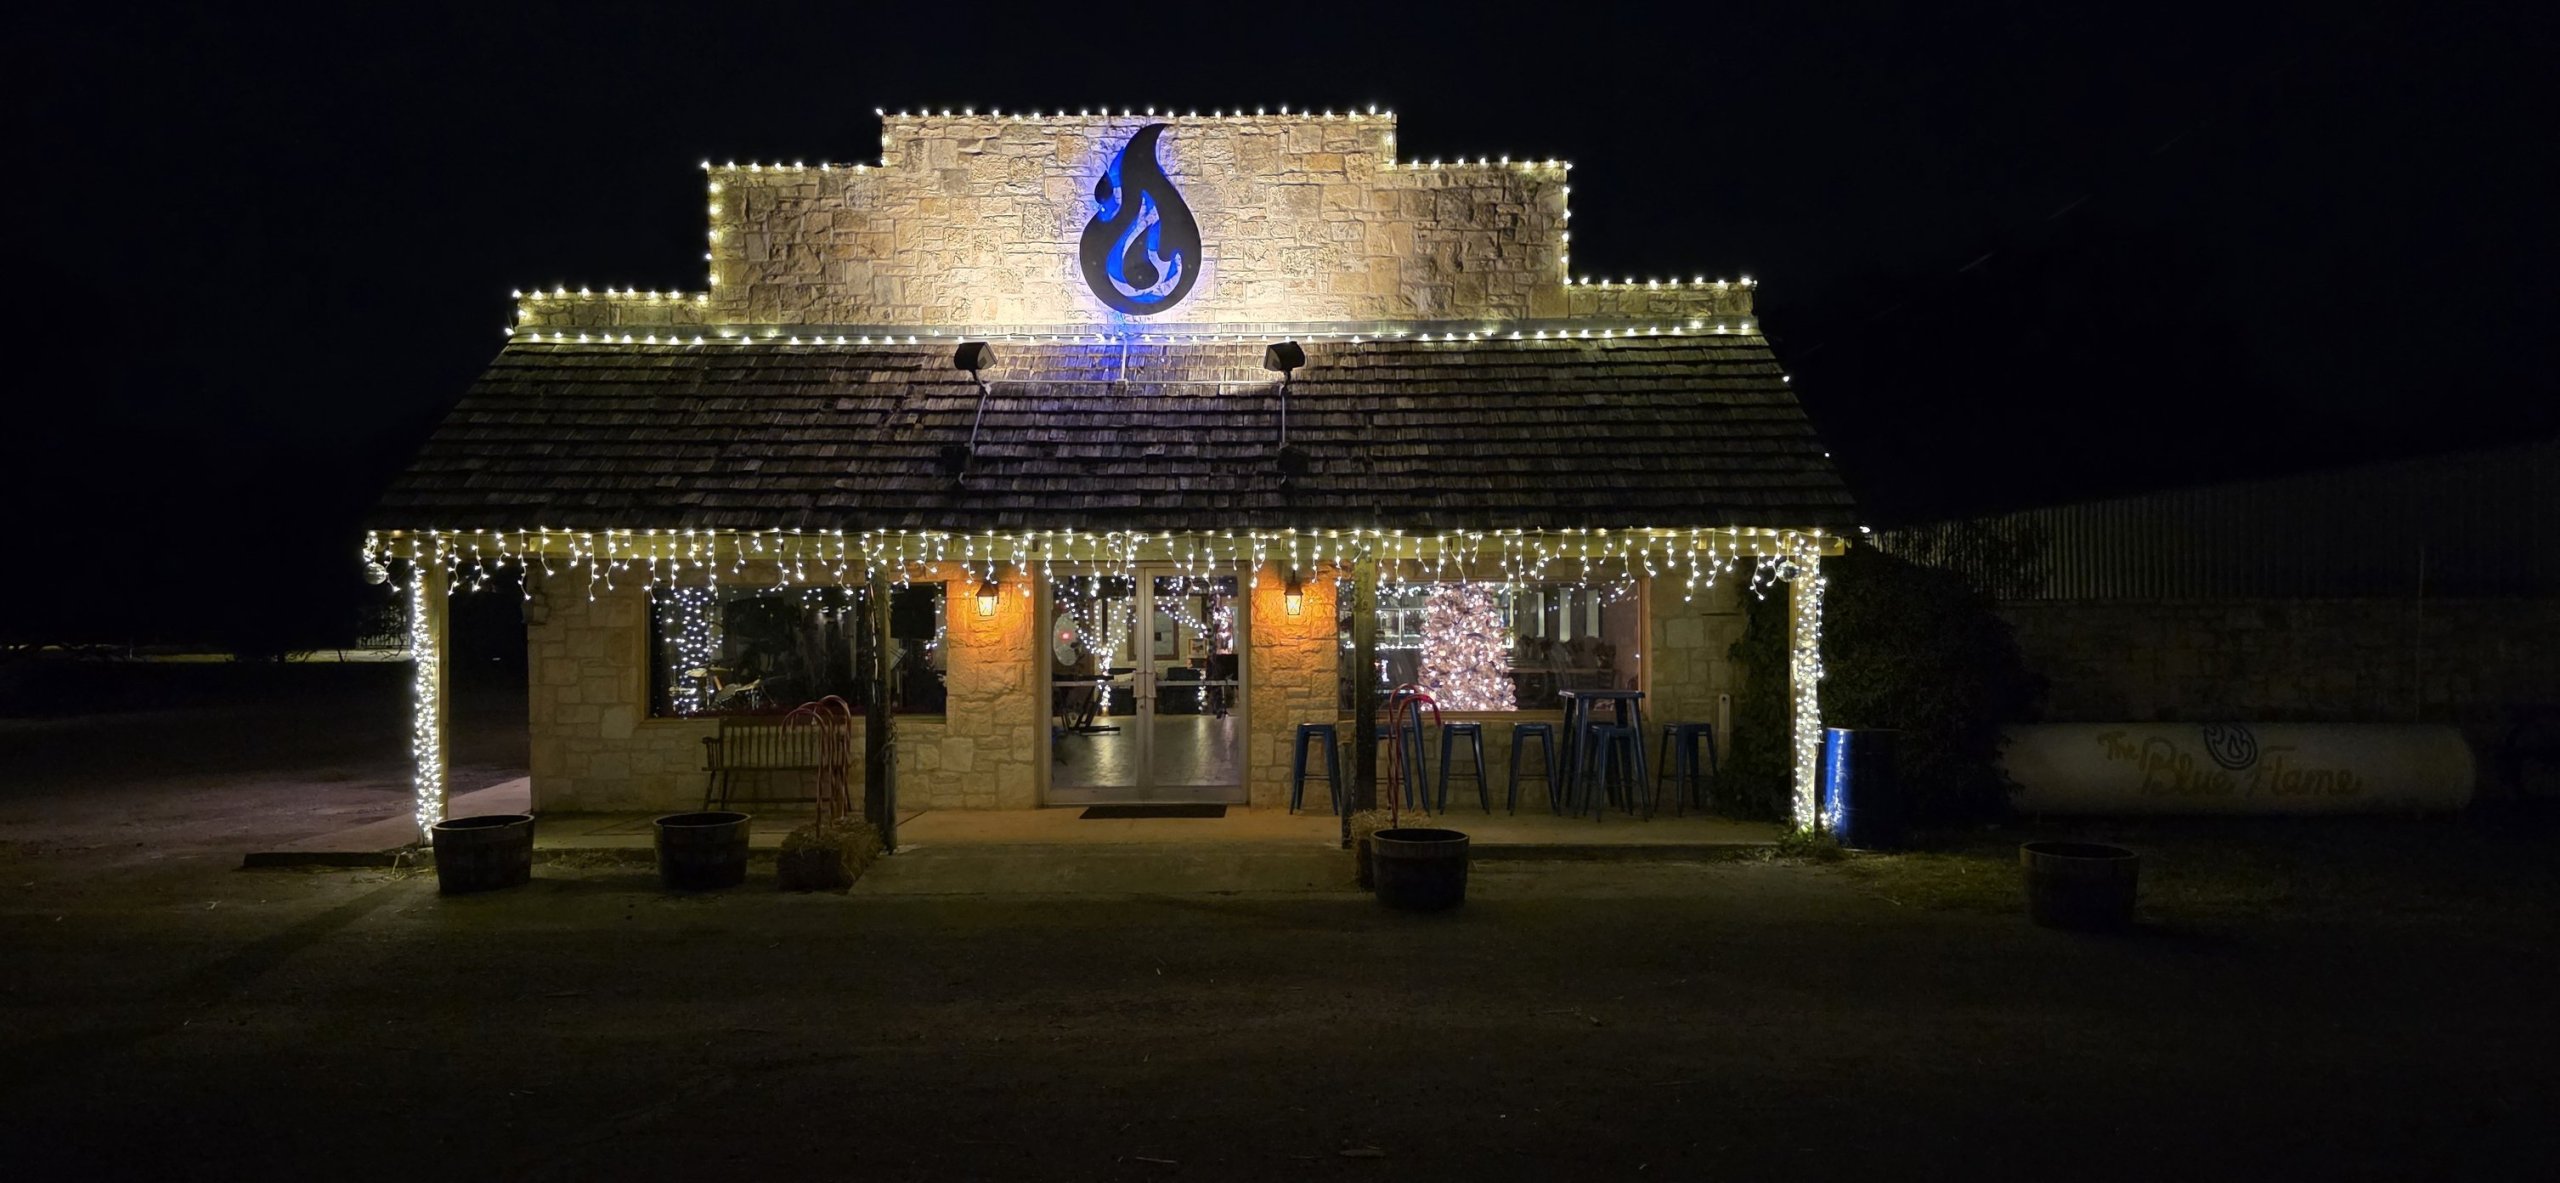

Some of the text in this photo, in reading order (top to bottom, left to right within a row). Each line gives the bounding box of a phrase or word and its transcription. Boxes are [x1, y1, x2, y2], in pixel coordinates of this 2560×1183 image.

[2097, 730, 2363, 798] The Blue Flame
